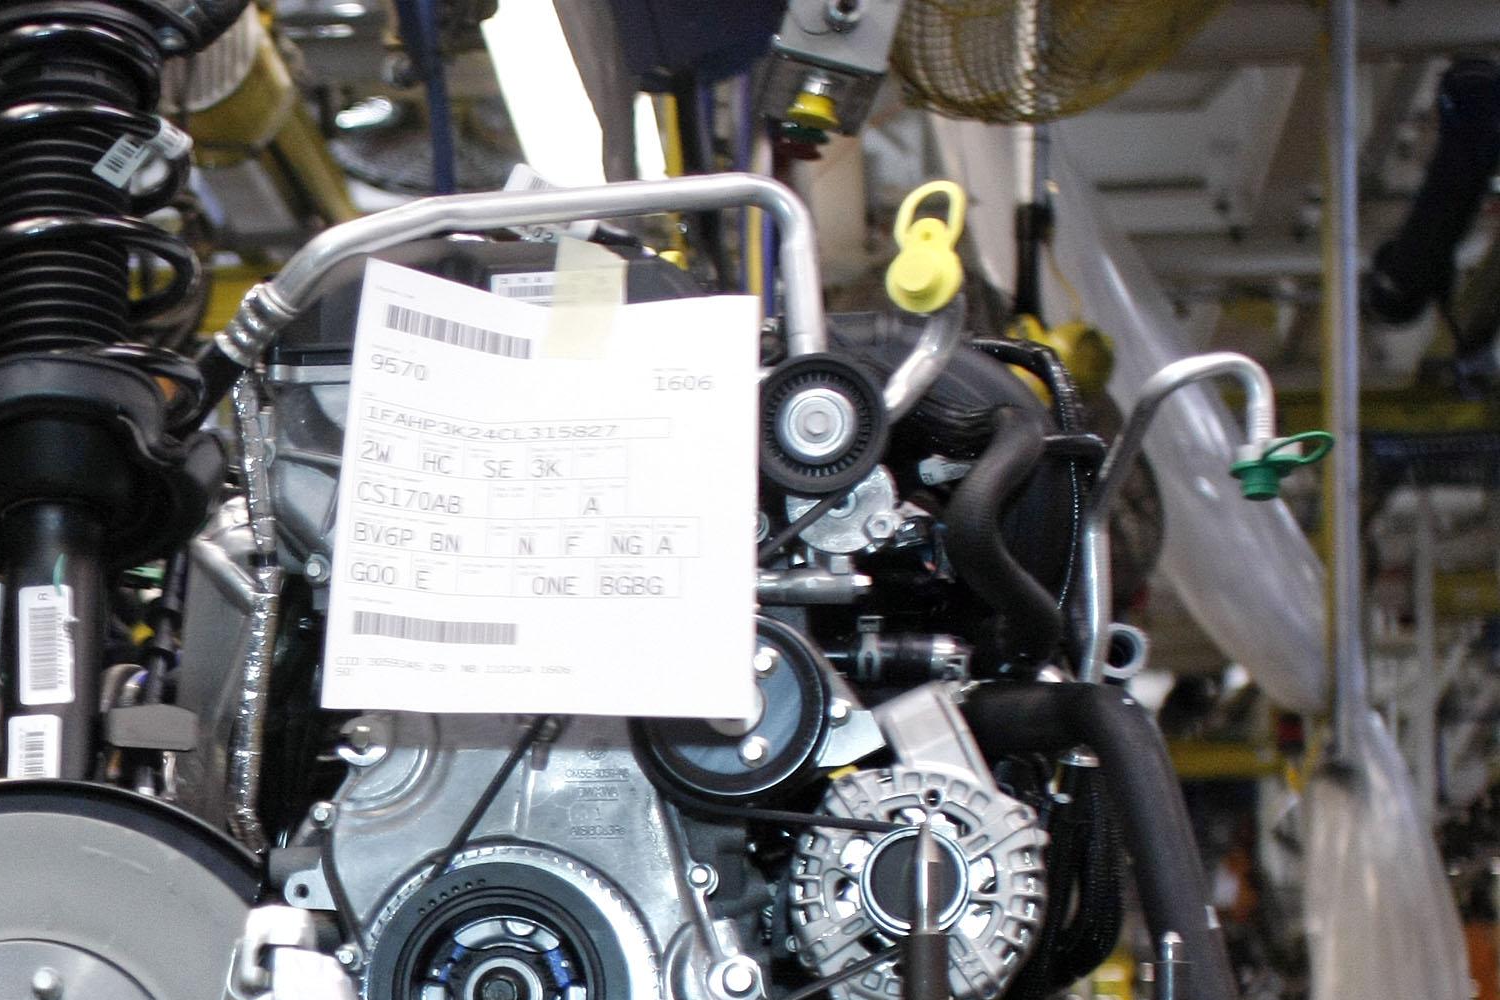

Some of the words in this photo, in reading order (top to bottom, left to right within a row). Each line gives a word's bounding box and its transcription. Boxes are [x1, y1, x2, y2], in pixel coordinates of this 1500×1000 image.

[370, 353, 429, 381] 9570
[653, 375, 715, 391] 1606
[367, 406, 621, 441] 1FAHP3K24CL315827
[360, 440, 392, 464] 2W
[422, 452, 453, 475] HC
[483, 459, 515, 479] SE
[531, 458, 564, 479] 3K
[357, 481, 463, 514] CS170AB
[582, 496, 603, 515] A
[354, 521, 415, 546] BV6P
[430, 532, 462, 553] BN
[518, 536, 536, 555] N
[564, 535, 585, 555] F
[609, 535, 645, 555] NG
[655, 535, 676, 555] A
[415, 569, 431, 590] E
